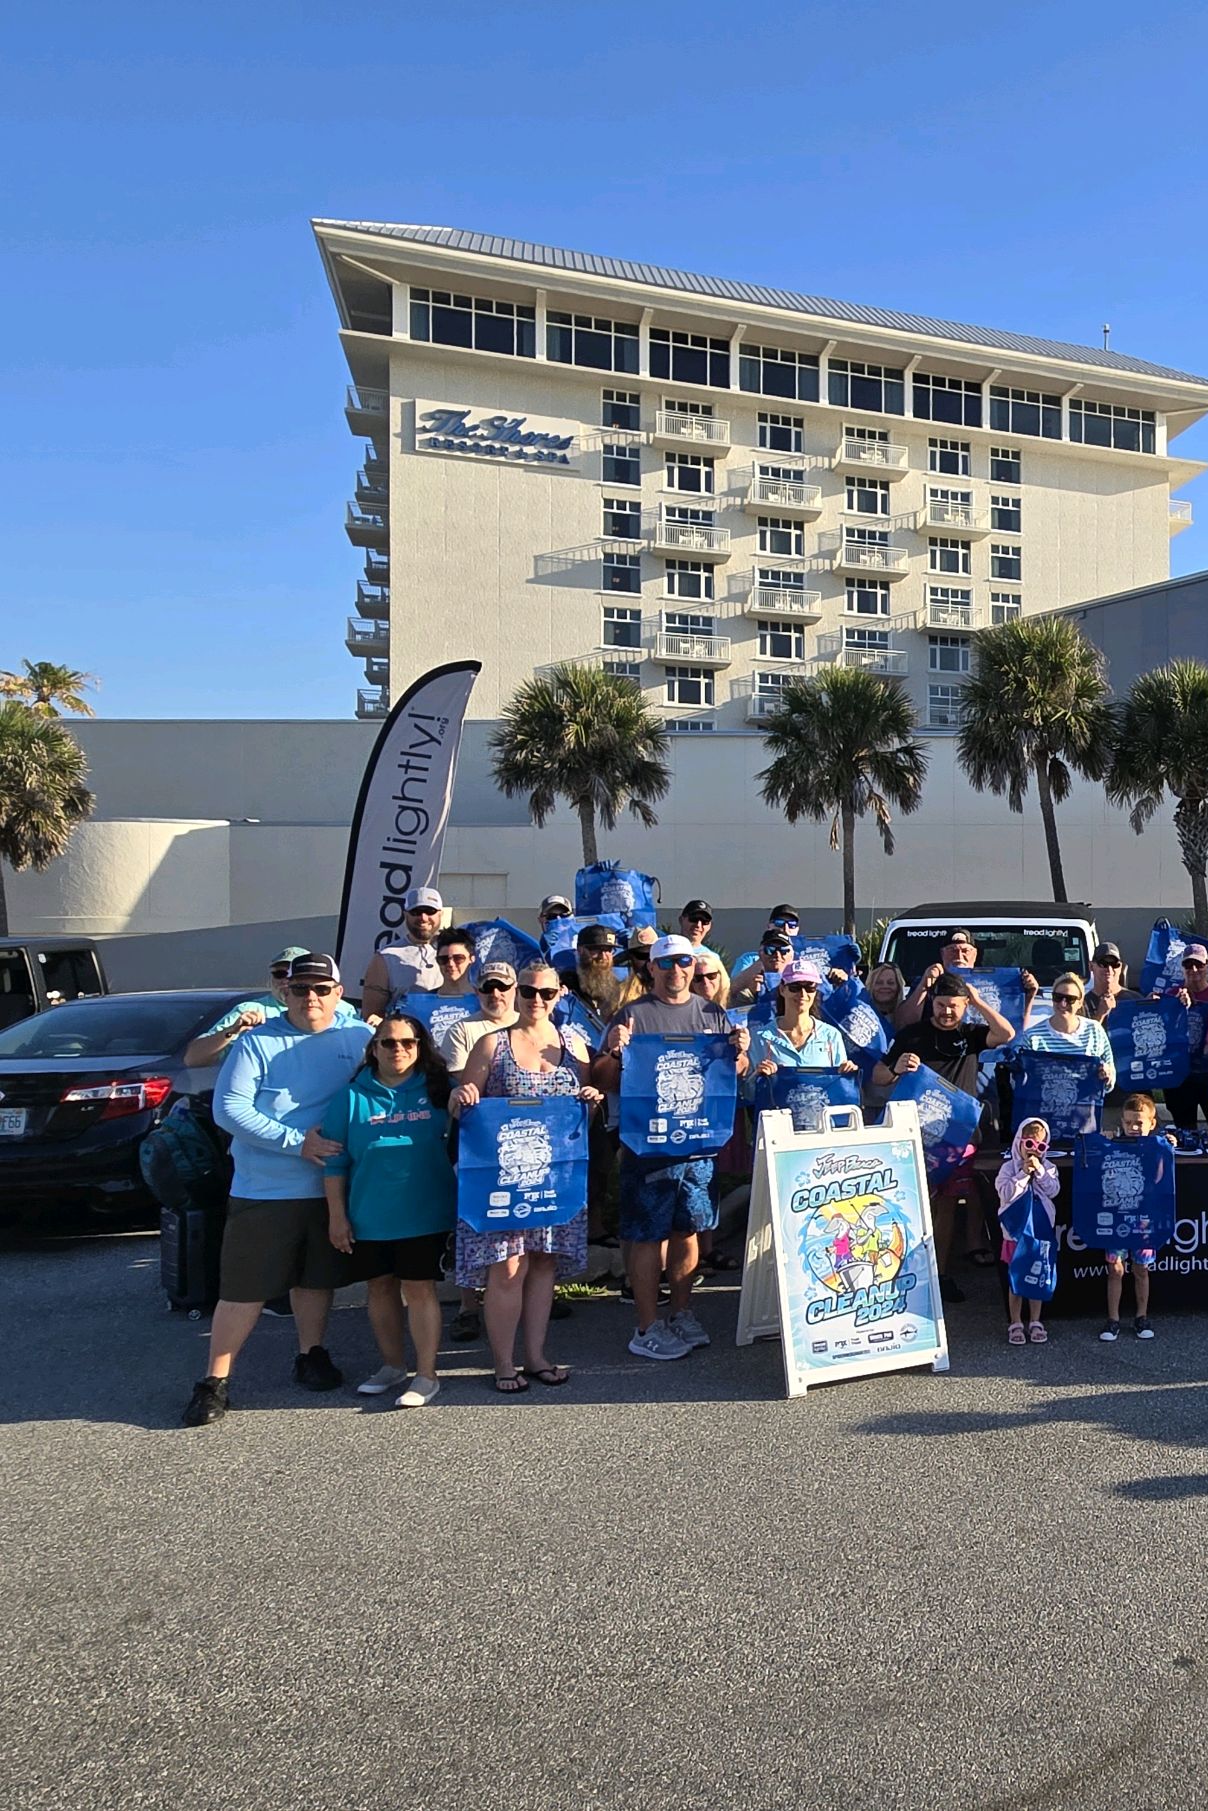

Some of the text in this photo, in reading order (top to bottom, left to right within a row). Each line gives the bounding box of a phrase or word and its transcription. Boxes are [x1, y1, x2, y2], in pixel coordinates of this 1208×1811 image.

[416, 408, 574, 450] The Shores
[429, 437, 509, 457] RESORT
[534, 450, 570, 464] SPA
[385, 707, 436, 854] lightly!
[1045, 929, 1068, 938] lightly!
[1132, 1016, 1162, 1028] COASTAL
[655, 1058, 701, 1071] COASTAL
[656, 1096, 703, 1114] CLEANUP
[497, 1126, 548, 1142] COASTAL
[1101, 1158, 1142, 1170] COASTAL
[497, 1166, 550, 1187] CLEANUP
[791, 1168, 898, 1213] COASTAL
[806, 1273, 917, 1325] CLEANUP
[854, 1297, 907, 1328] 2024
